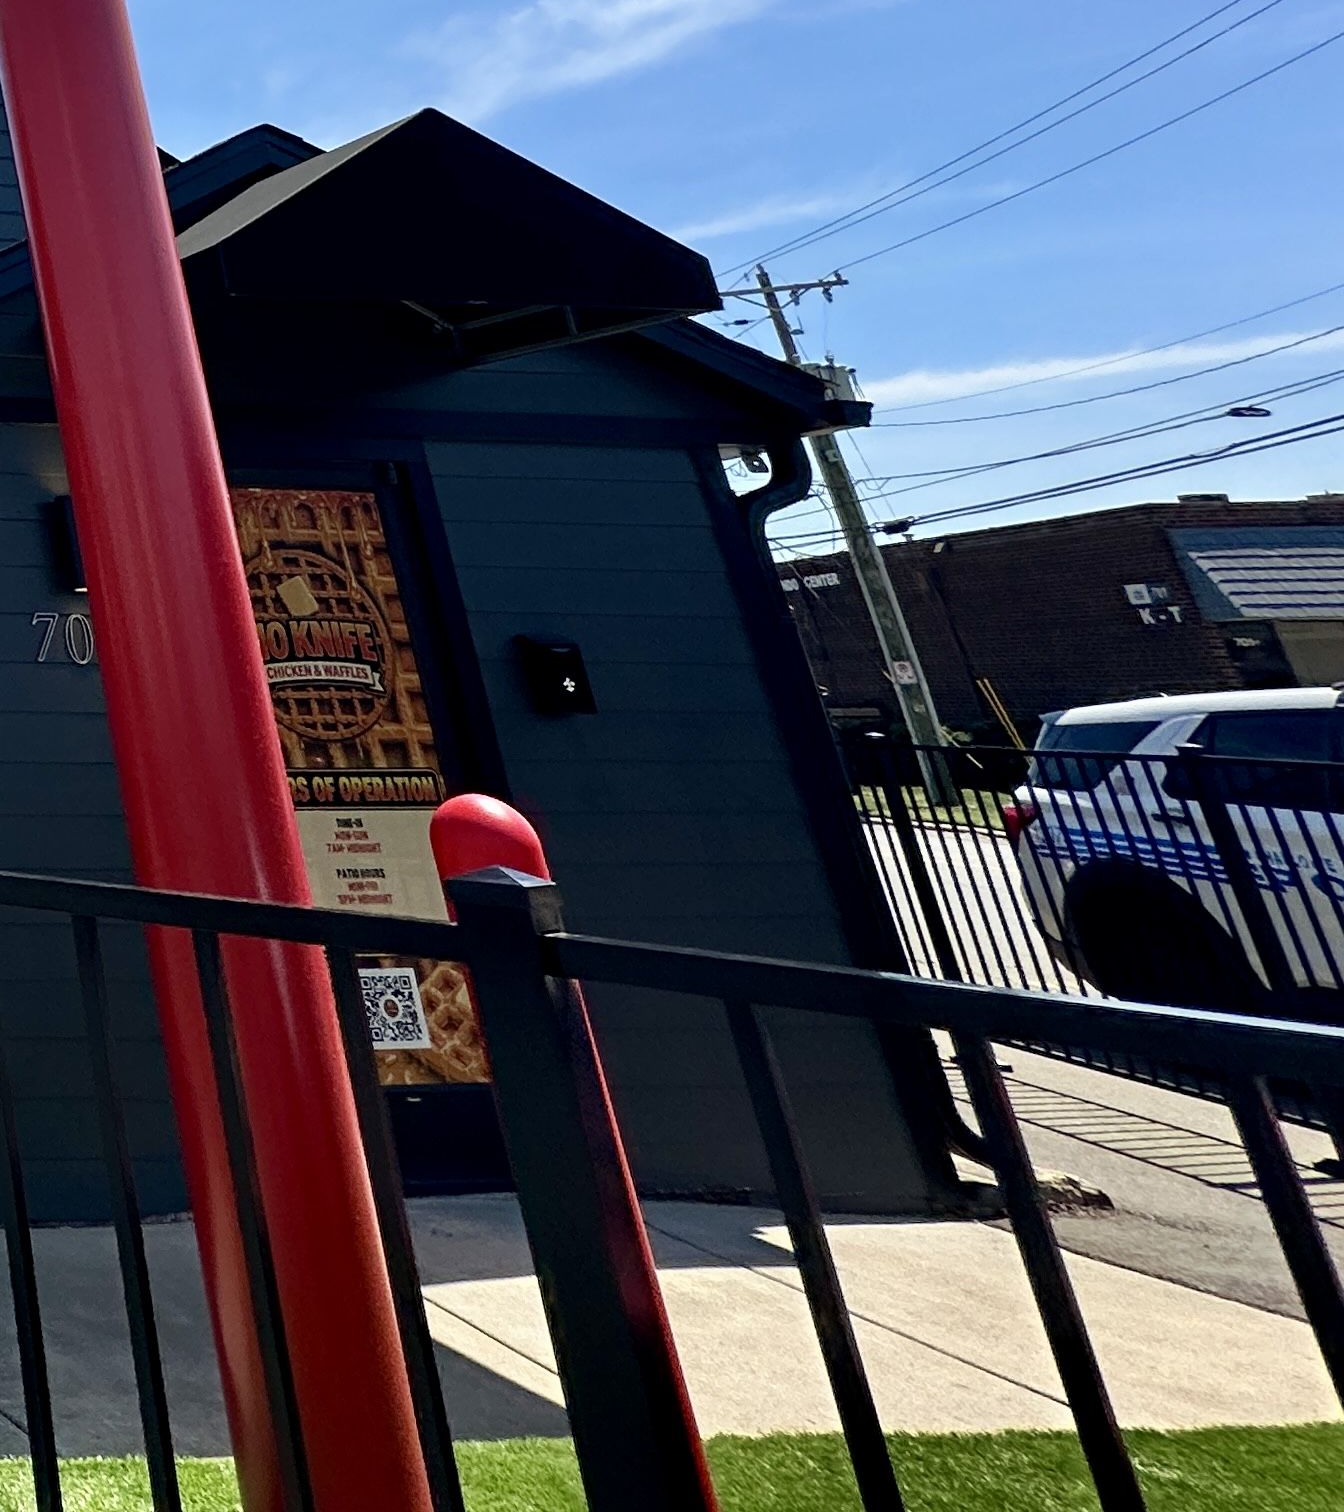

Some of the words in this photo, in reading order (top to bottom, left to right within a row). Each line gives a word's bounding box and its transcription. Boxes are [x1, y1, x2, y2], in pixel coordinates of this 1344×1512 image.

[803, 572, 840, 589] CENTER
[289, 619, 378, 662] KNIFE
[267, 663, 312, 679] CHICKEN
[322, 663, 369, 679] WAFFLES
[312, 776, 336, 802] OF
[338, 775, 439, 803] OPERATION
[336, 868, 359, 879] PATIO
